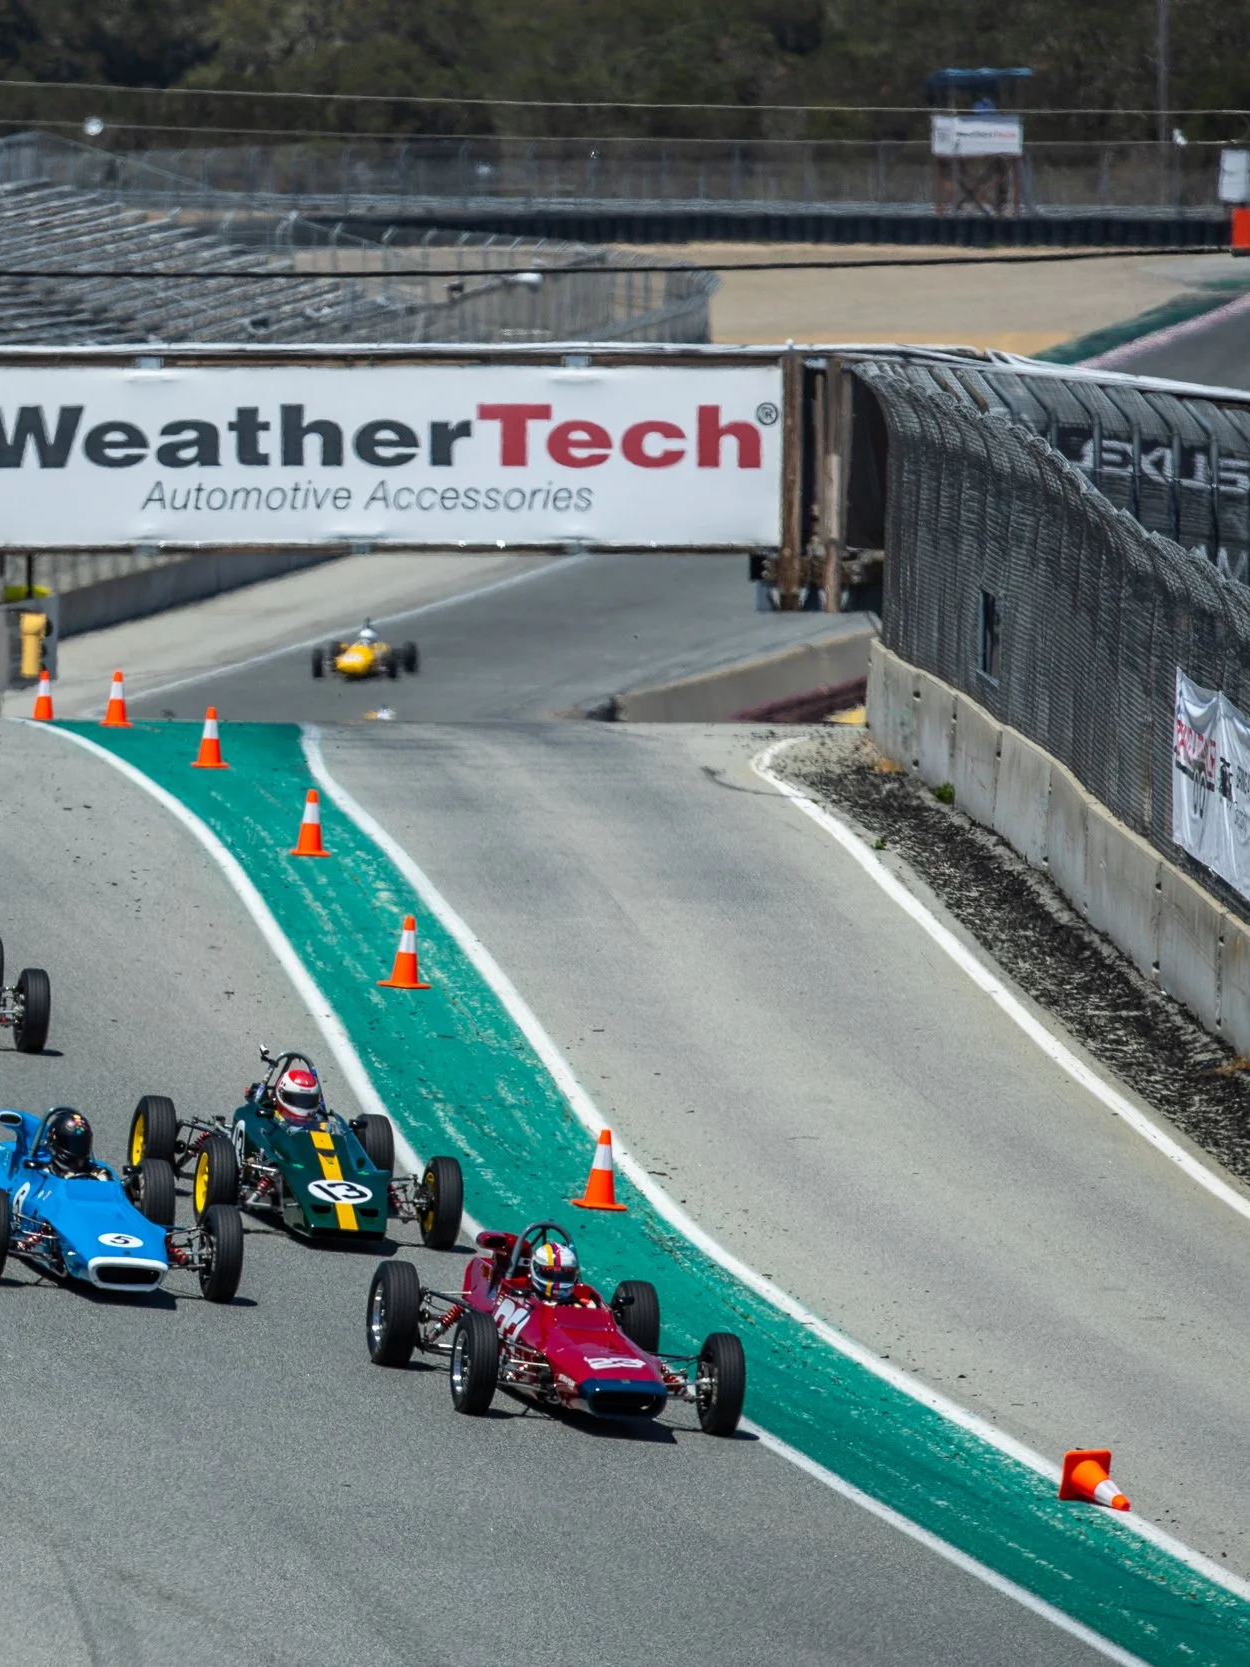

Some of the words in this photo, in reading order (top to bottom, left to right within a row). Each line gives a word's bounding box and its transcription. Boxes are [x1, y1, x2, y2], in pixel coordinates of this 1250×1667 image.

[141, 479, 352, 512] Automotive
[363, 479, 594, 512] Accessories
[312, 1181, 369, 1202] 13
[109, 1234, 134, 1245] 5
